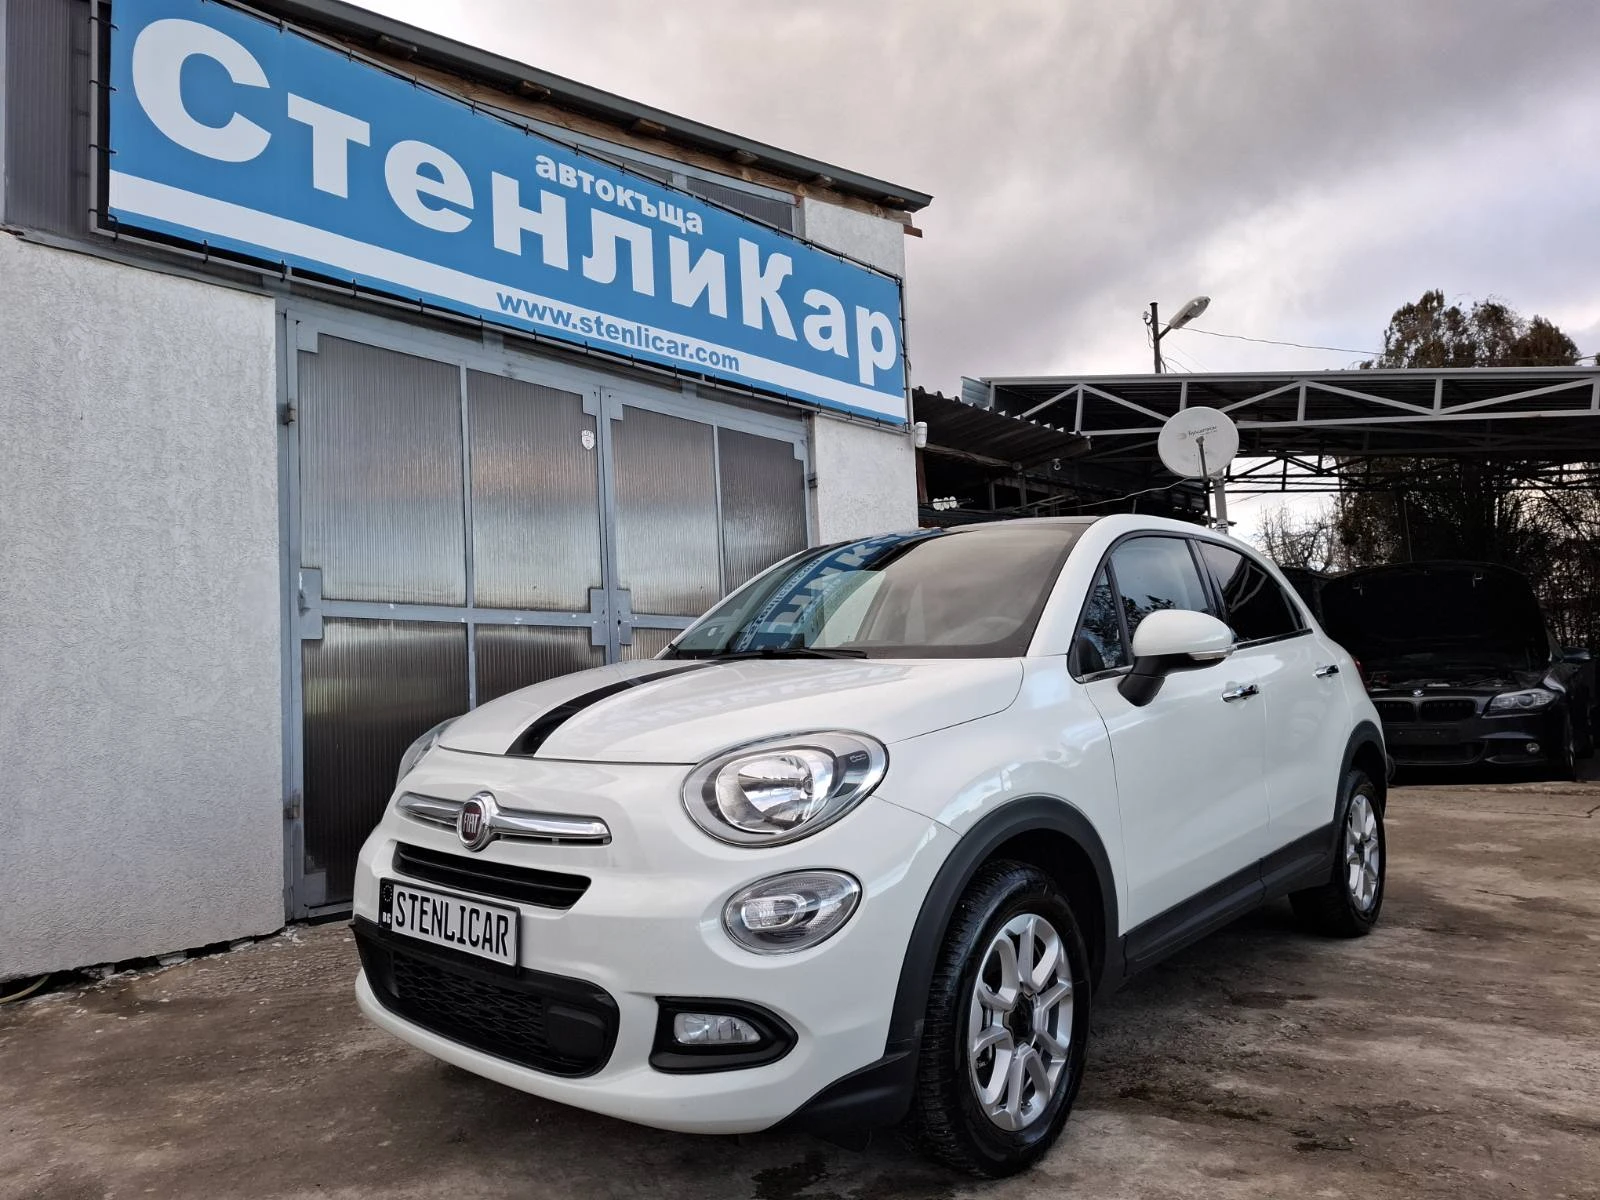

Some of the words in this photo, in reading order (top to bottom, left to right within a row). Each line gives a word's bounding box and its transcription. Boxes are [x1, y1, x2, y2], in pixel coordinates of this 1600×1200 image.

[132, 18, 897, 386] СтенлиКар
[535, 154, 703, 236] автокъща
[496, 292, 740, 373] www.stenlicar.com
[463, 812, 480, 833] FIAT
[395, 891, 508, 957] STENLICAR
